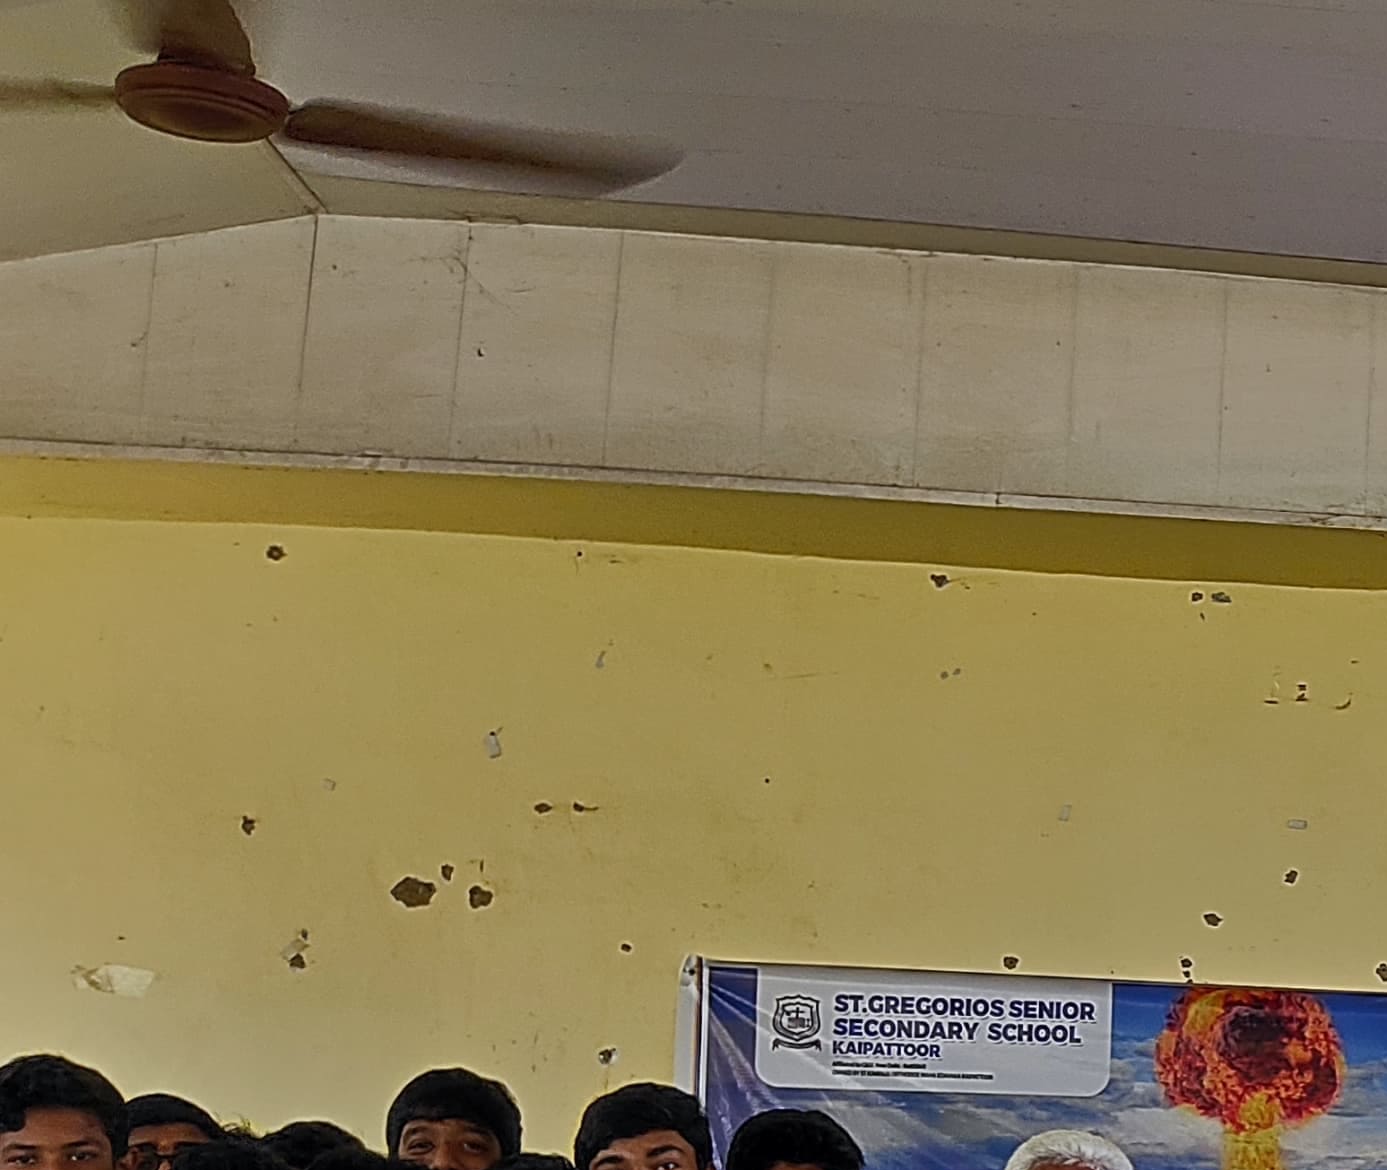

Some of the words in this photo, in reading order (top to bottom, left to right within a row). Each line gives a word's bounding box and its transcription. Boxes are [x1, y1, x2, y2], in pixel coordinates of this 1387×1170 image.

[1008, 1000, 1095, 1020] SENIOR
[833, 1018, 980, 1041] SECONDARY
[987, 1023, 1082, 1044] SCHOOL
[832, 1040, 941, 1058] KAIPATTOOR
